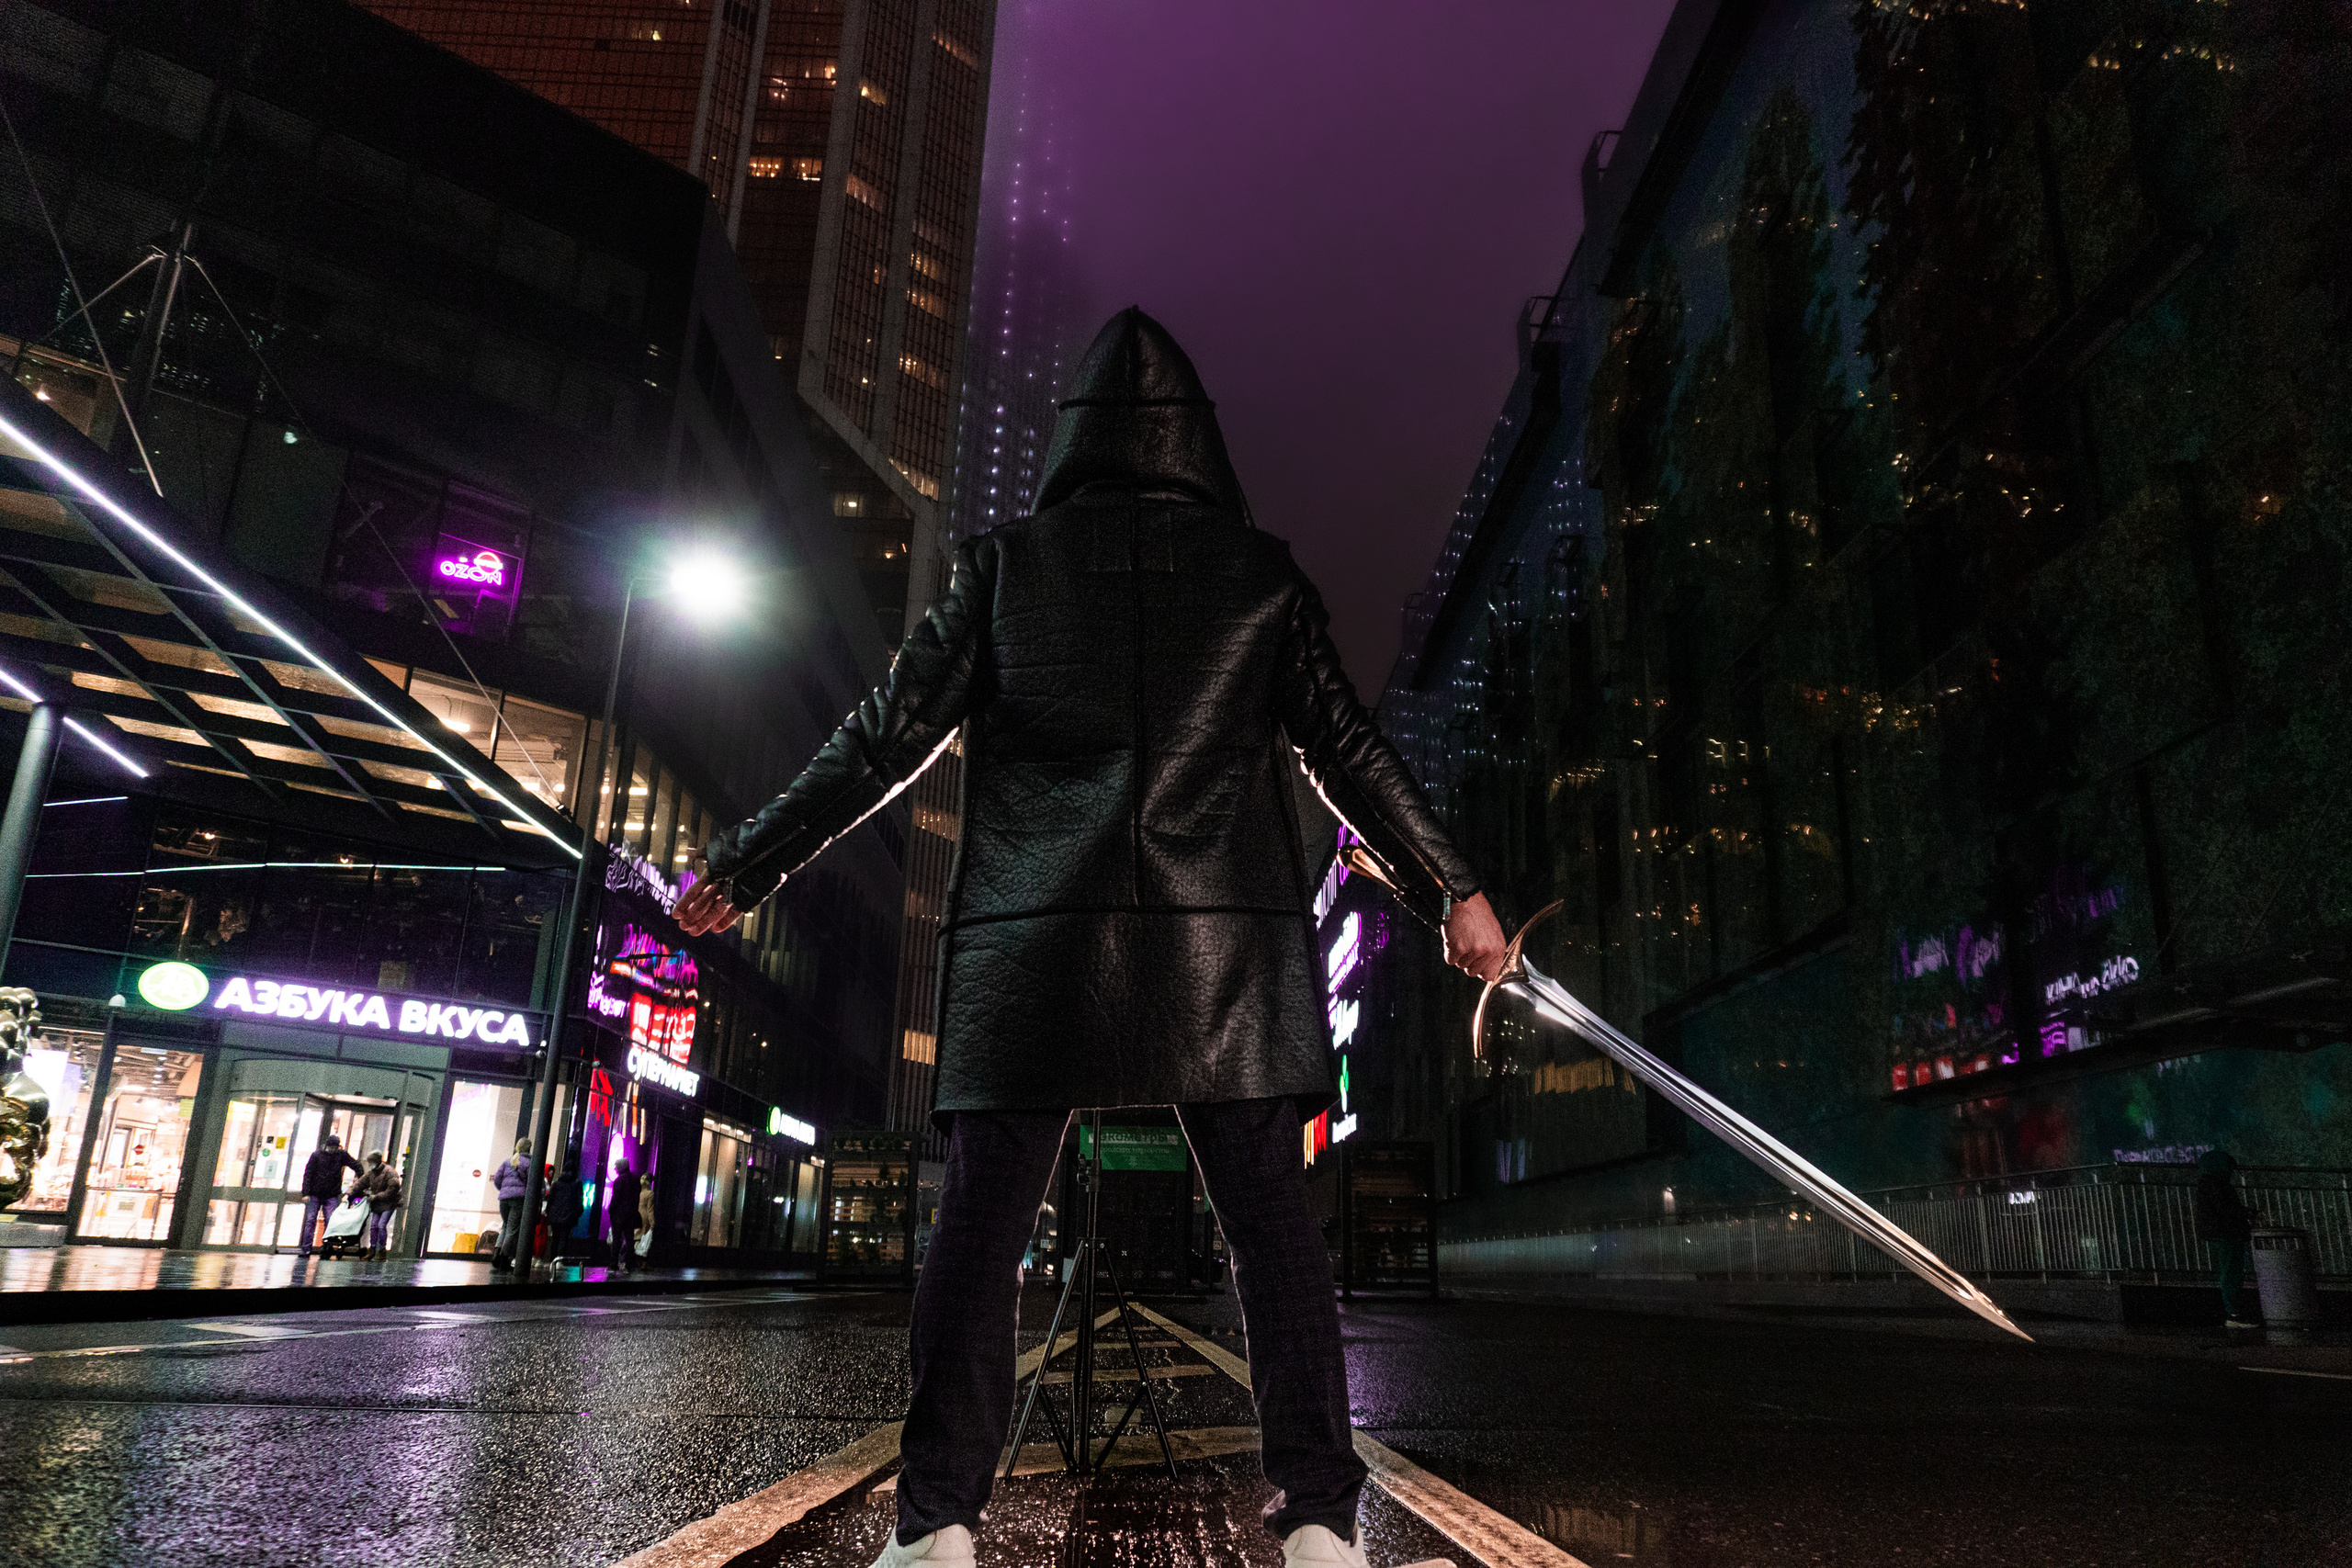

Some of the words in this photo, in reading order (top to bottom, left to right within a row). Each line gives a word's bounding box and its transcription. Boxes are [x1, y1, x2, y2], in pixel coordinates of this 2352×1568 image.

[441, 560, 502, 585] OZON
[215, 977, 391, 1030] АЗБУКА
[399, 999, 531, 1047] ВКУСА
[627, 1047, 701, 1098] СУПЕРМАРКЕТ
